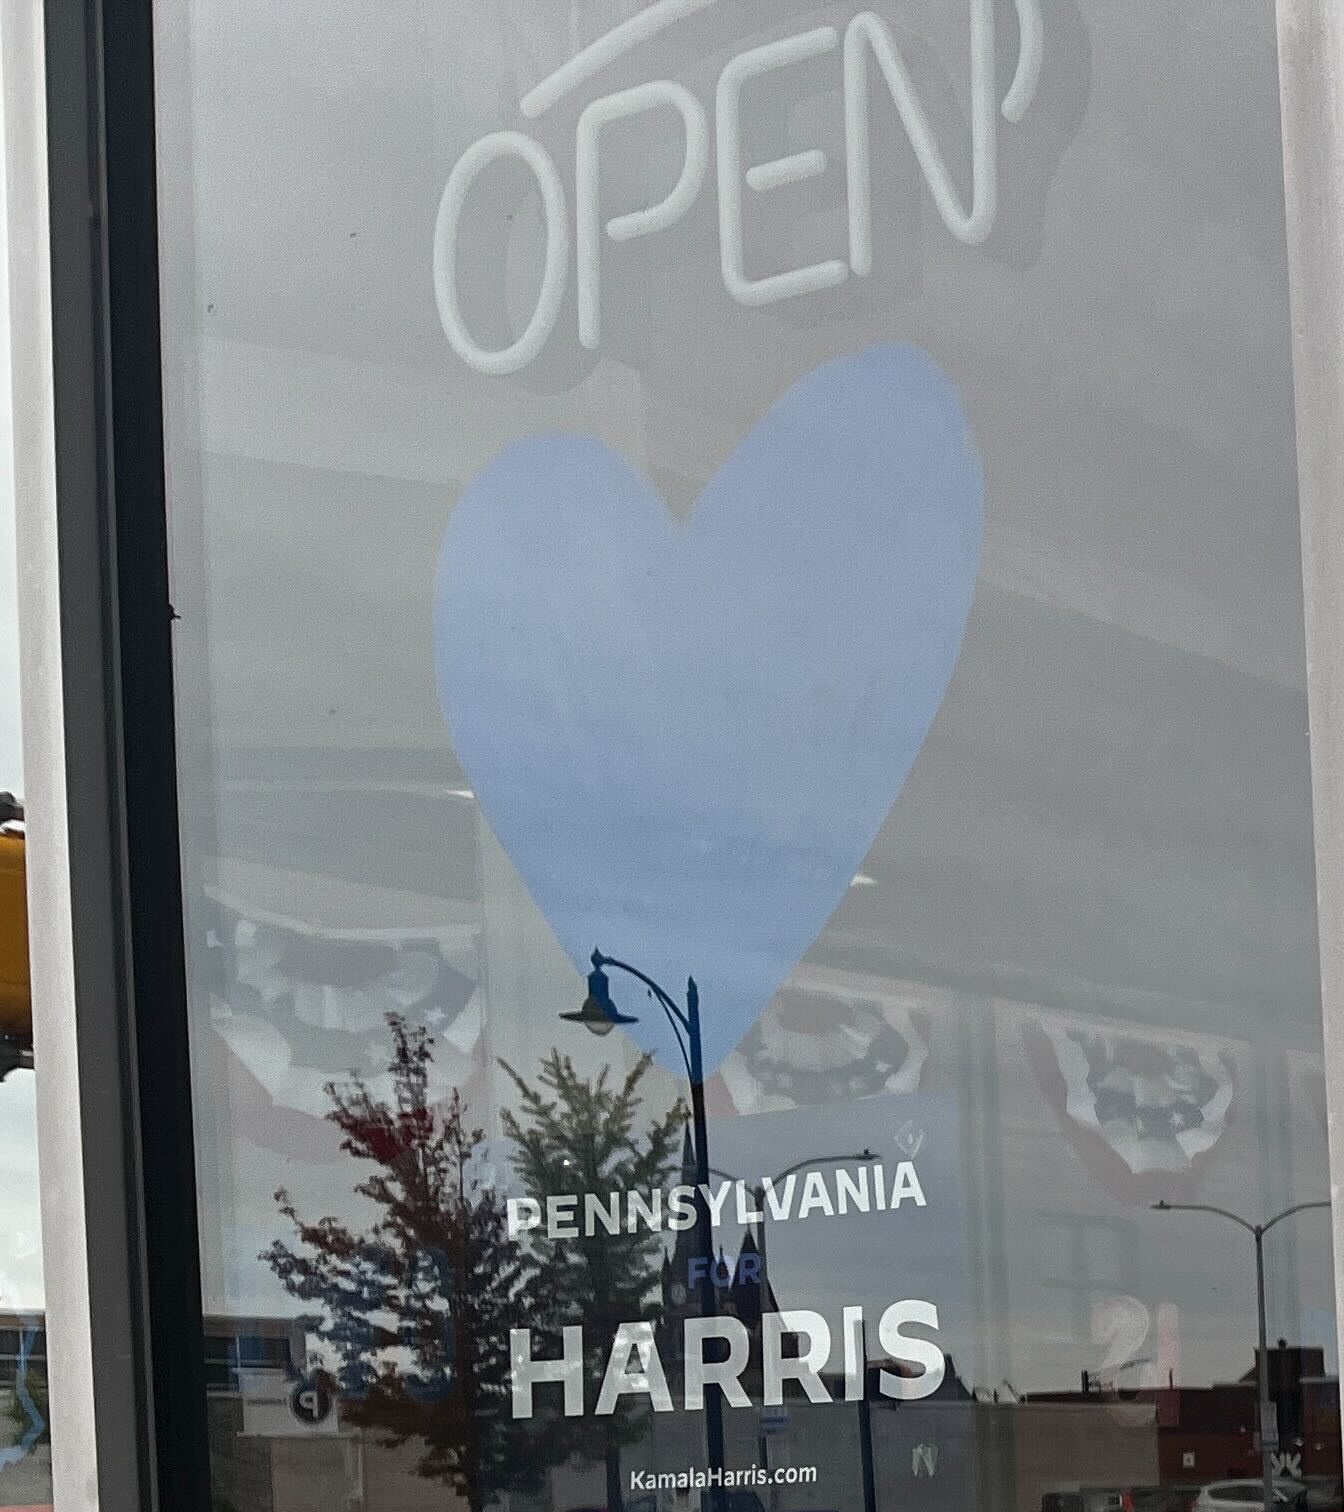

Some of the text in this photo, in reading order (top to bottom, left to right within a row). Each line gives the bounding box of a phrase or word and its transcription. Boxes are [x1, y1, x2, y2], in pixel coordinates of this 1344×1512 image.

[433, 0, 998, 375] OPEN
[506, 1160, 927, 1241] PENNSYLVANIA
[687, 1252, 763, 1290] FOR
[510, 1299, 946, 1418] HARRIS
[629, 1463, 818, 1490] KamalaHarris.com
